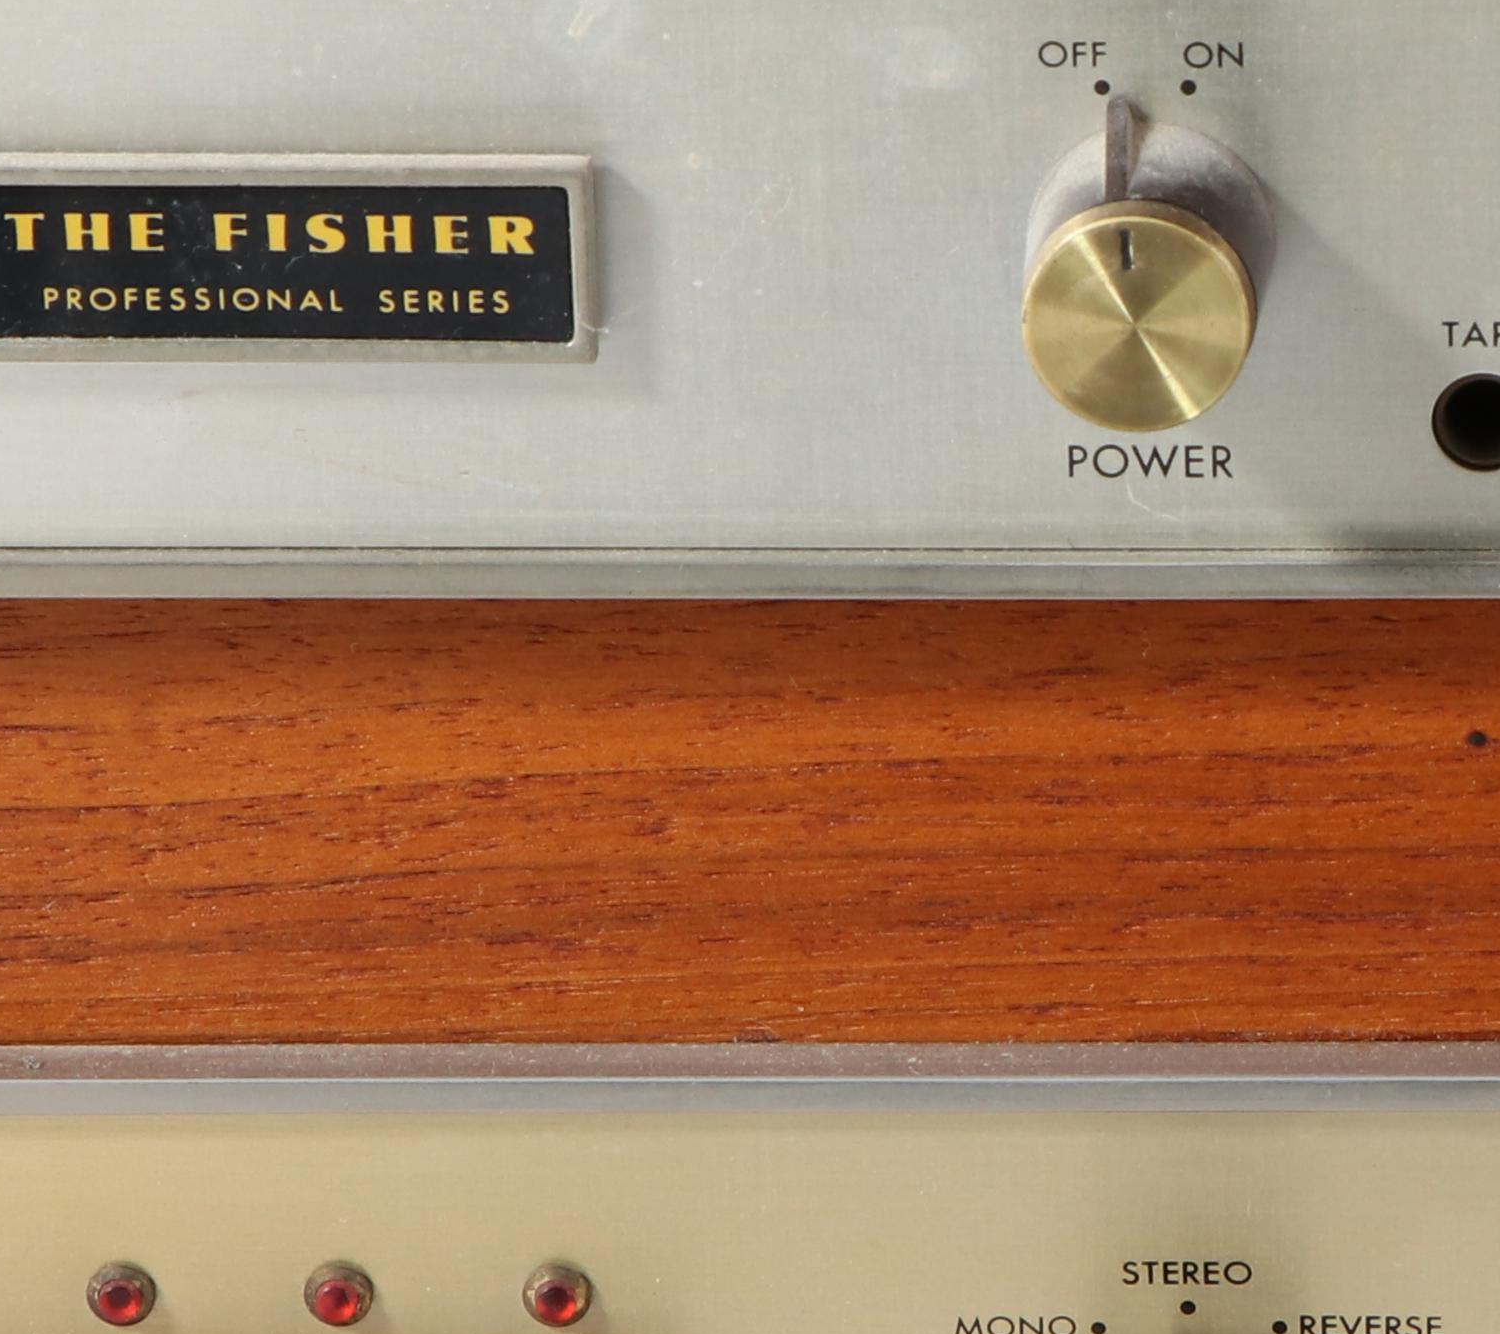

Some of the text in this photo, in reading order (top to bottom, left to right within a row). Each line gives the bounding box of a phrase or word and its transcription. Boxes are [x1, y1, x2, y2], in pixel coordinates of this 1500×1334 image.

[1038, 40, 1244, 69] OFF ON
[3, 213, 535, 255] THE FISHER
[43, 287, 510, 314] PROFESSIONAL SERIES
[1068, 444, 1233, 479] POWER
[1122, 1261, 1253, 1285] STEREO
